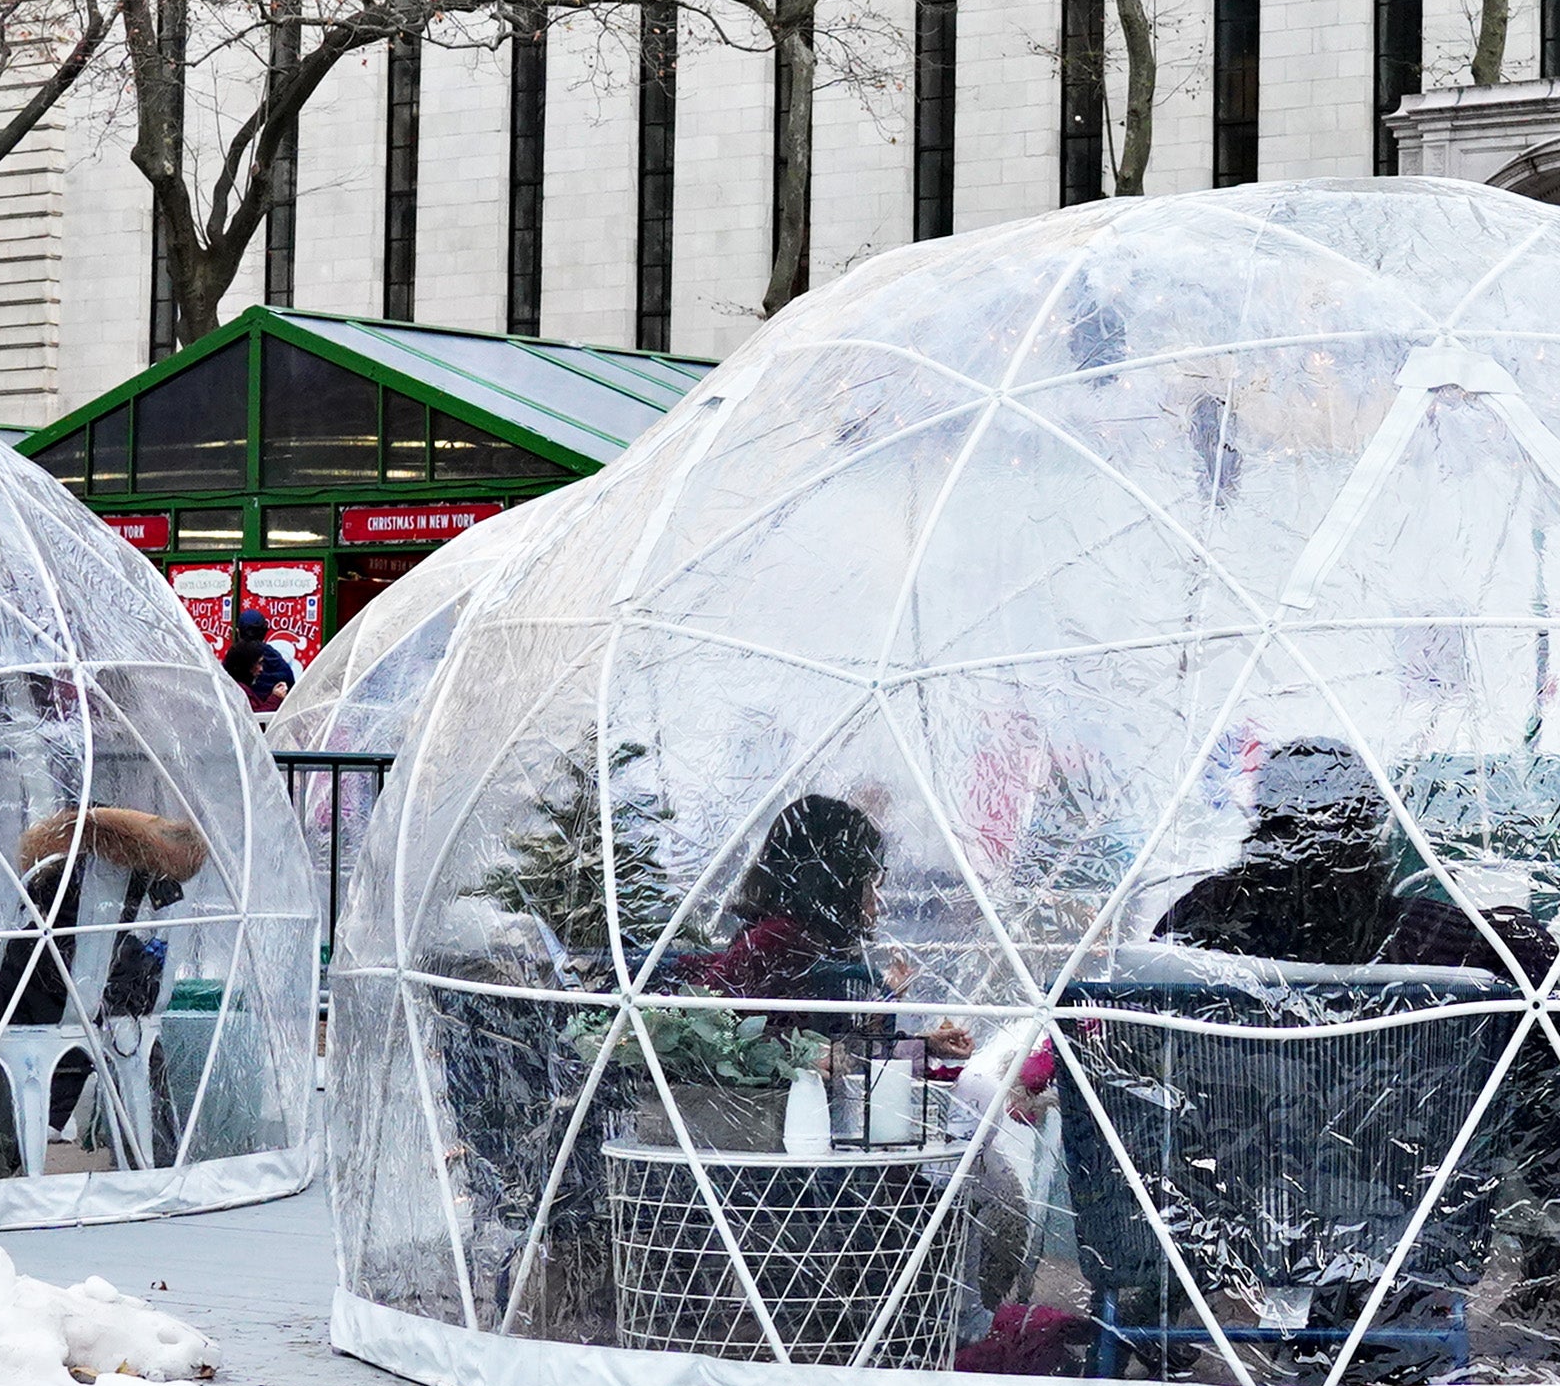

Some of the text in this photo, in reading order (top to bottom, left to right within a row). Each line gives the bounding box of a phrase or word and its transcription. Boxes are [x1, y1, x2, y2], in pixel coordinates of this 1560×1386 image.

[367, 513, 476, 531] CHRISTMAS IN NEW YORK
[123, 524, 146, 539] YORK
[191, 602, 213, 617] HOT
[269, 601, 294, 616] HOT
[193, 616, 233, 640] COLATE
